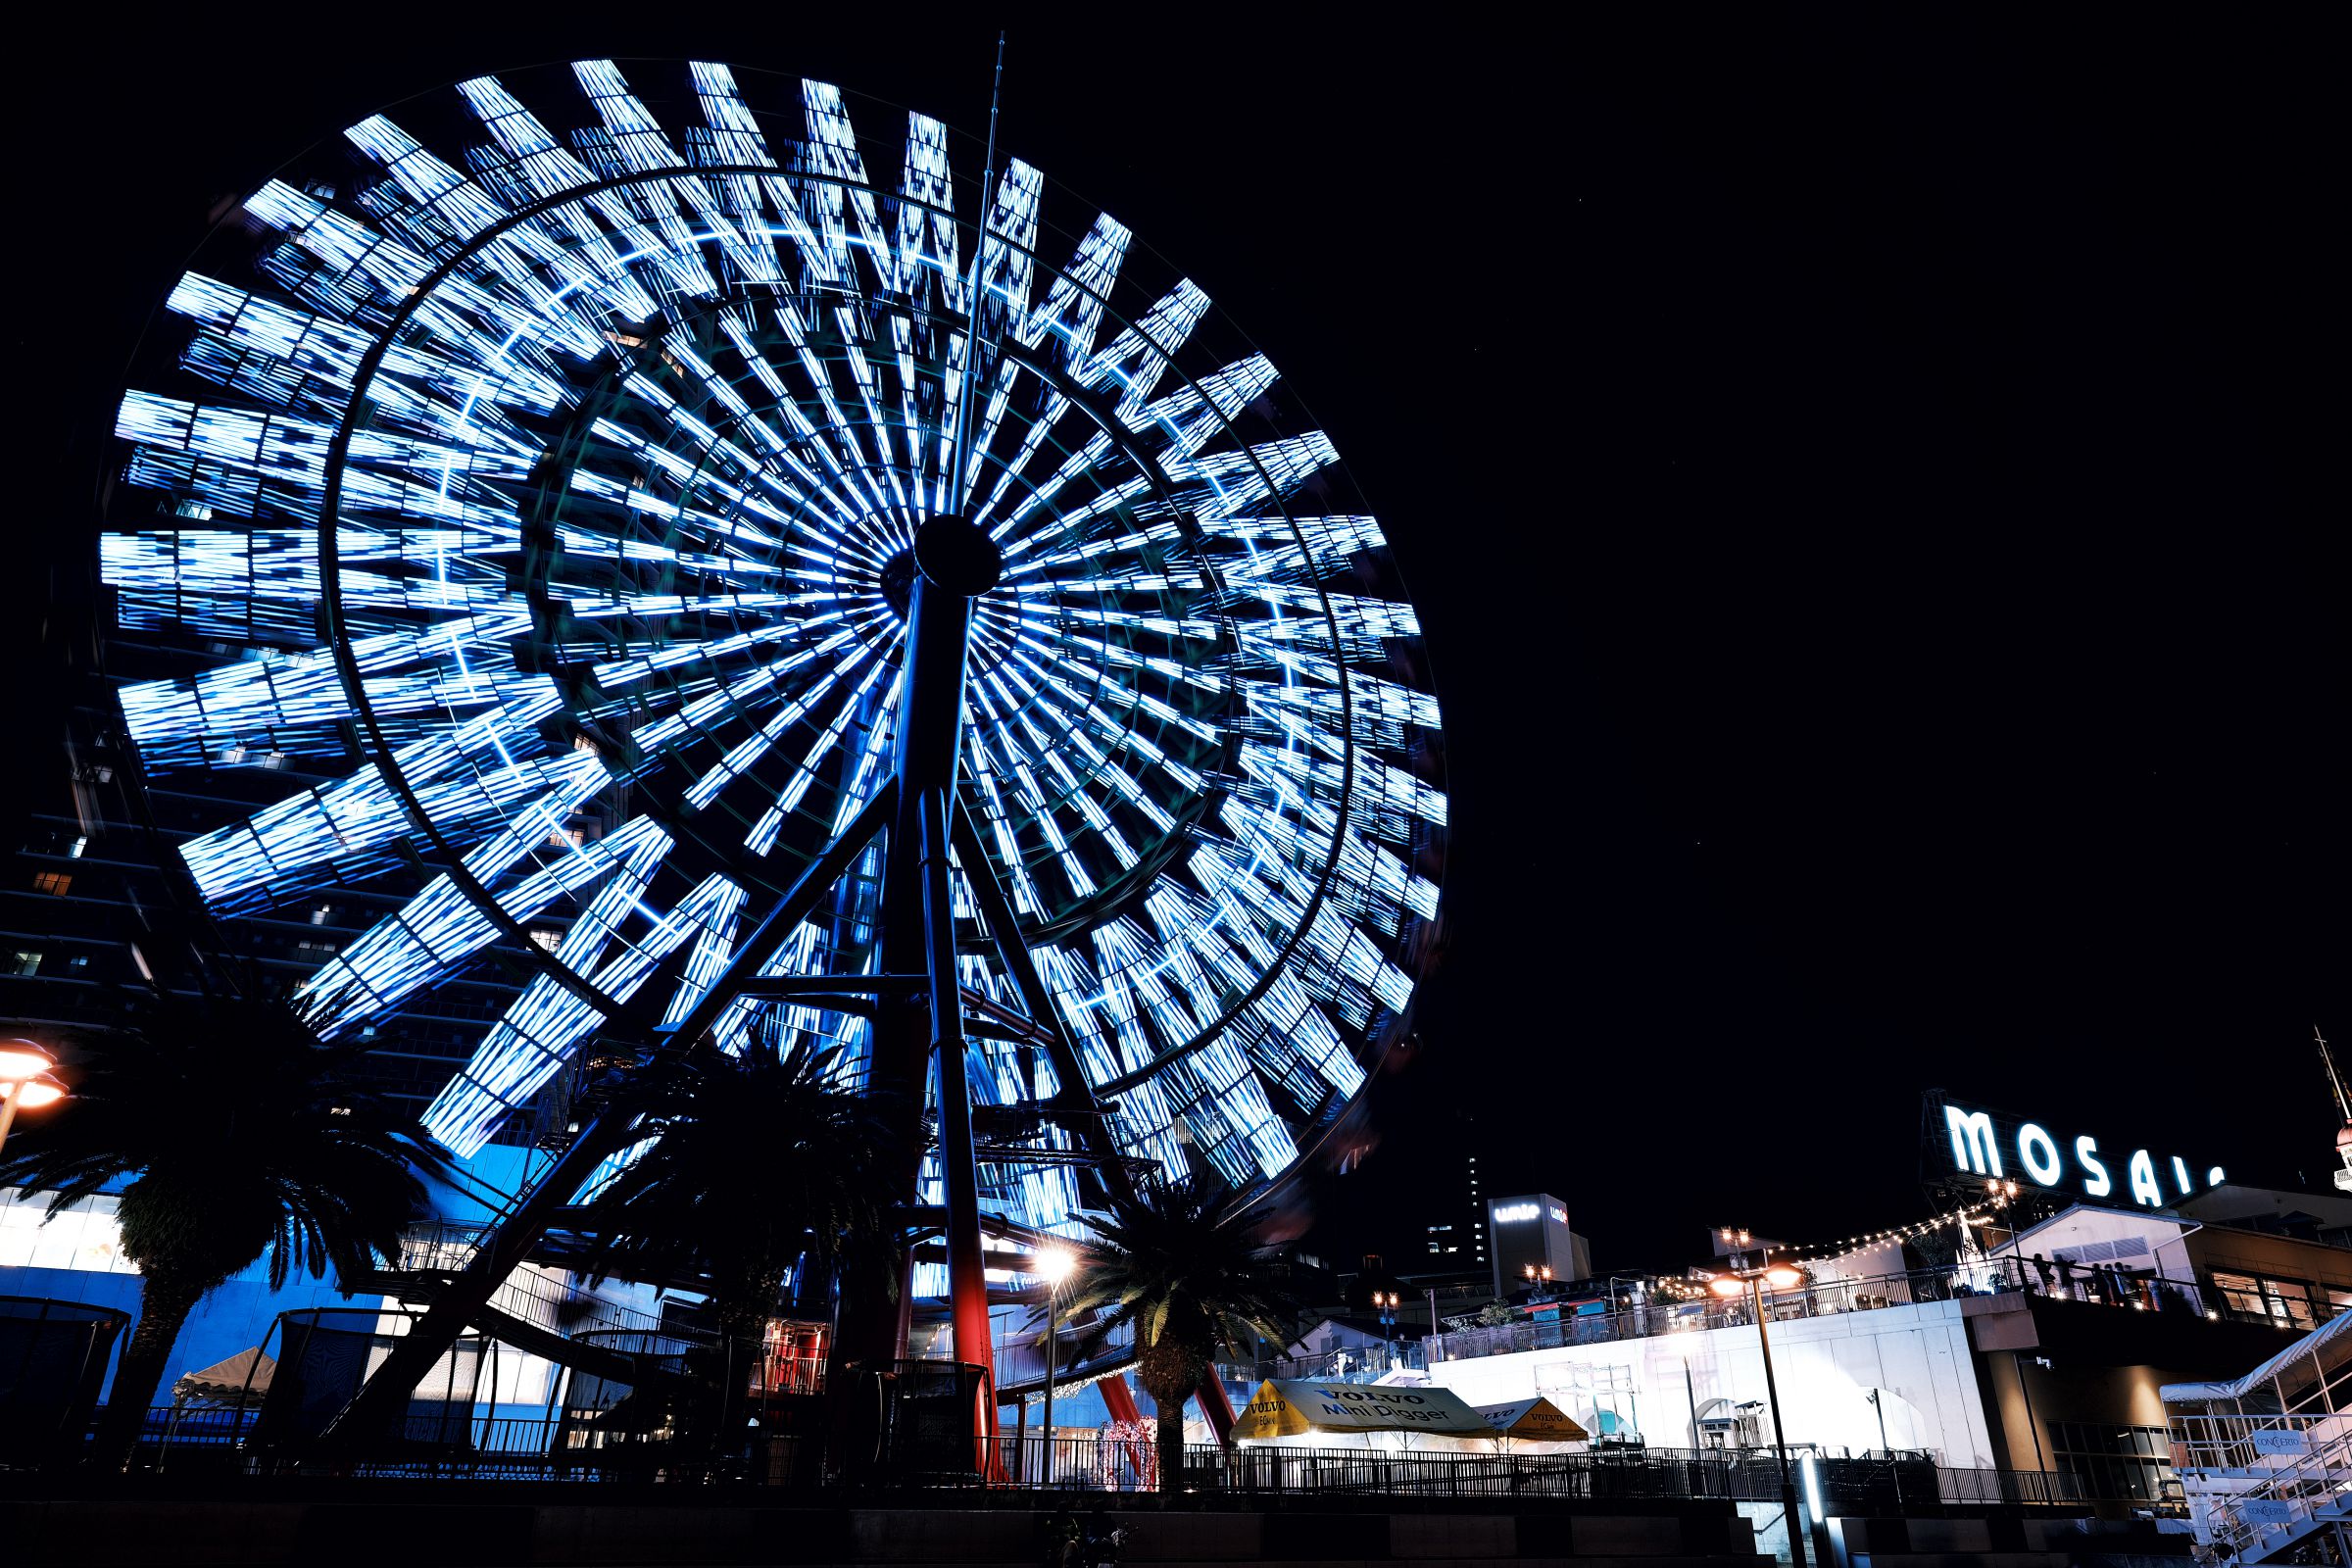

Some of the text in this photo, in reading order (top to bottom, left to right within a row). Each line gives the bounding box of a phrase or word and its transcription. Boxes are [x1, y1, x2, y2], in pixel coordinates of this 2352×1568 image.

[1494, 1203, 1540, 1222] umie
[1315, 1390, 1426, 1405] VOLVO
[1250, 1400, 1286, 1414] VOLVO
[1321, 1403, 1450, 1422] Mini Digger
[1531, 1413, 1563, 1422] VOLVO
